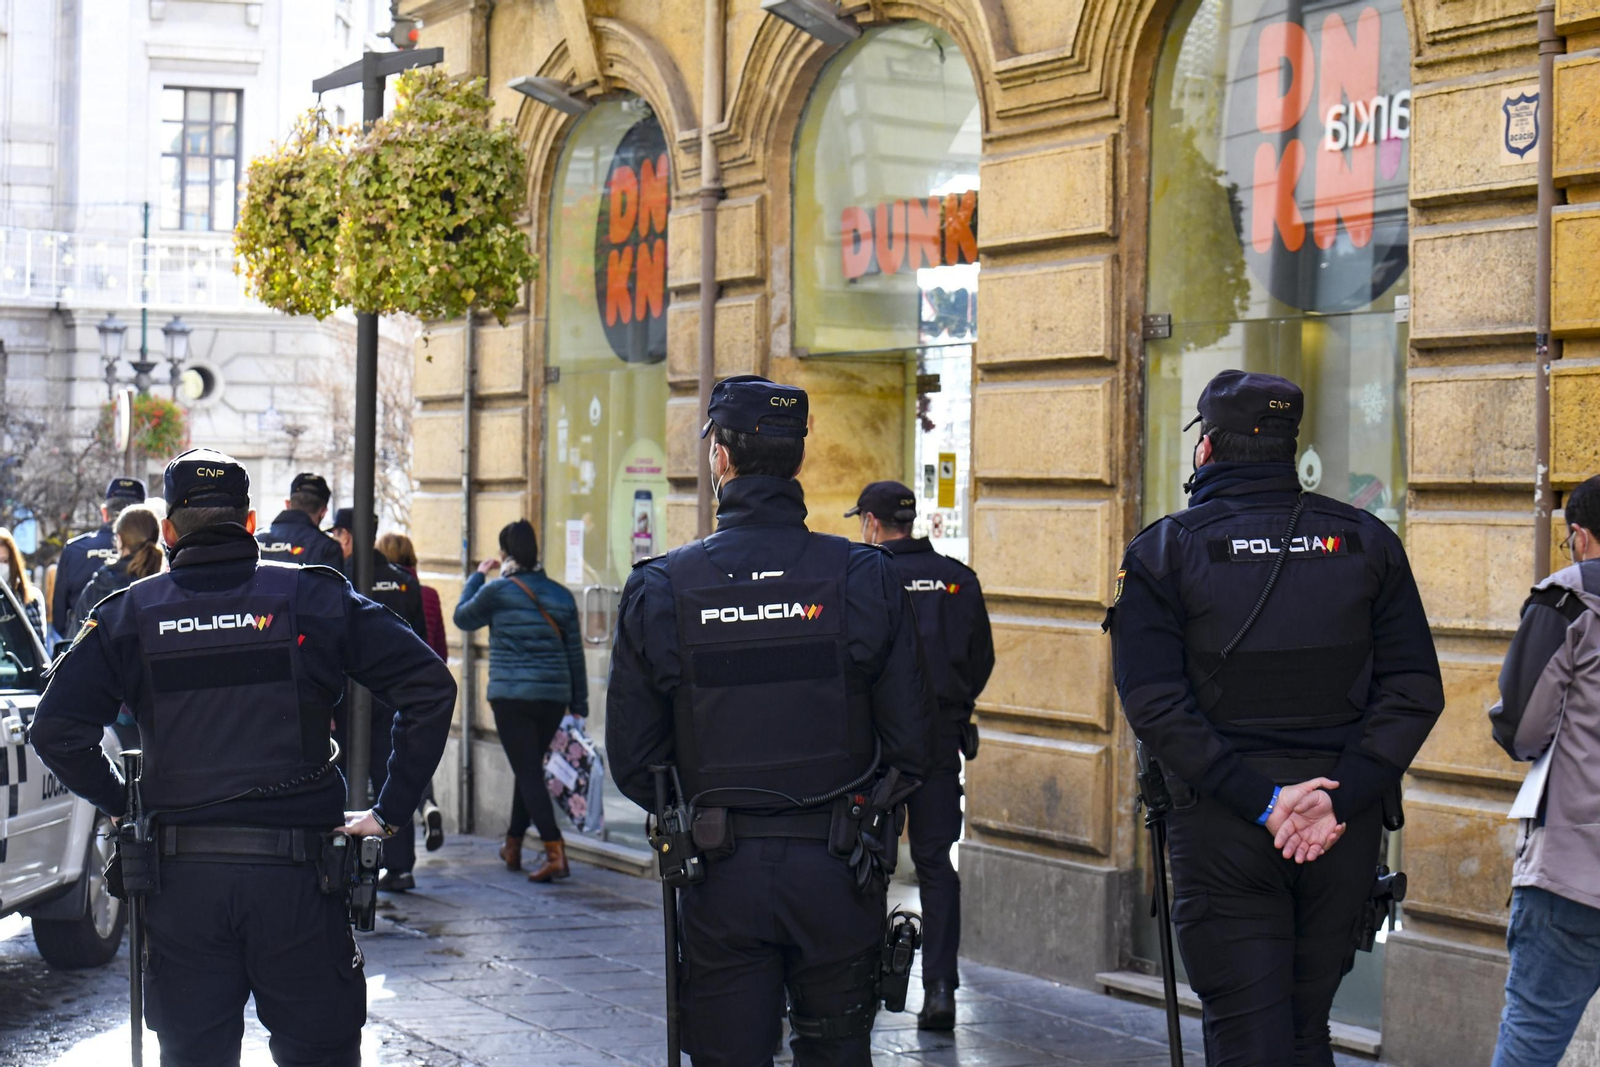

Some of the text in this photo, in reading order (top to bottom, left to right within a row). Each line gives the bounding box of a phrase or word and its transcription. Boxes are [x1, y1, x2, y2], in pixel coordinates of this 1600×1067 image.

[1257, 7, 1380, 134] DN
[609, 153, 668, 244] DN
[1252, 137, 1376, 254] KN
[841, 190, 978, 279] DUNK
[606, 238, 665, 327] KN
[770, 396, 797, 407] CNP
[1269, 399, 1291, 409] CNP
[196, 467, 225, 478] CNP
[1231, 535, 1326, 554] POLCIA
[159, 613, 257, 635] POLICIA
[701, 602, 805, 624] POLICIA
